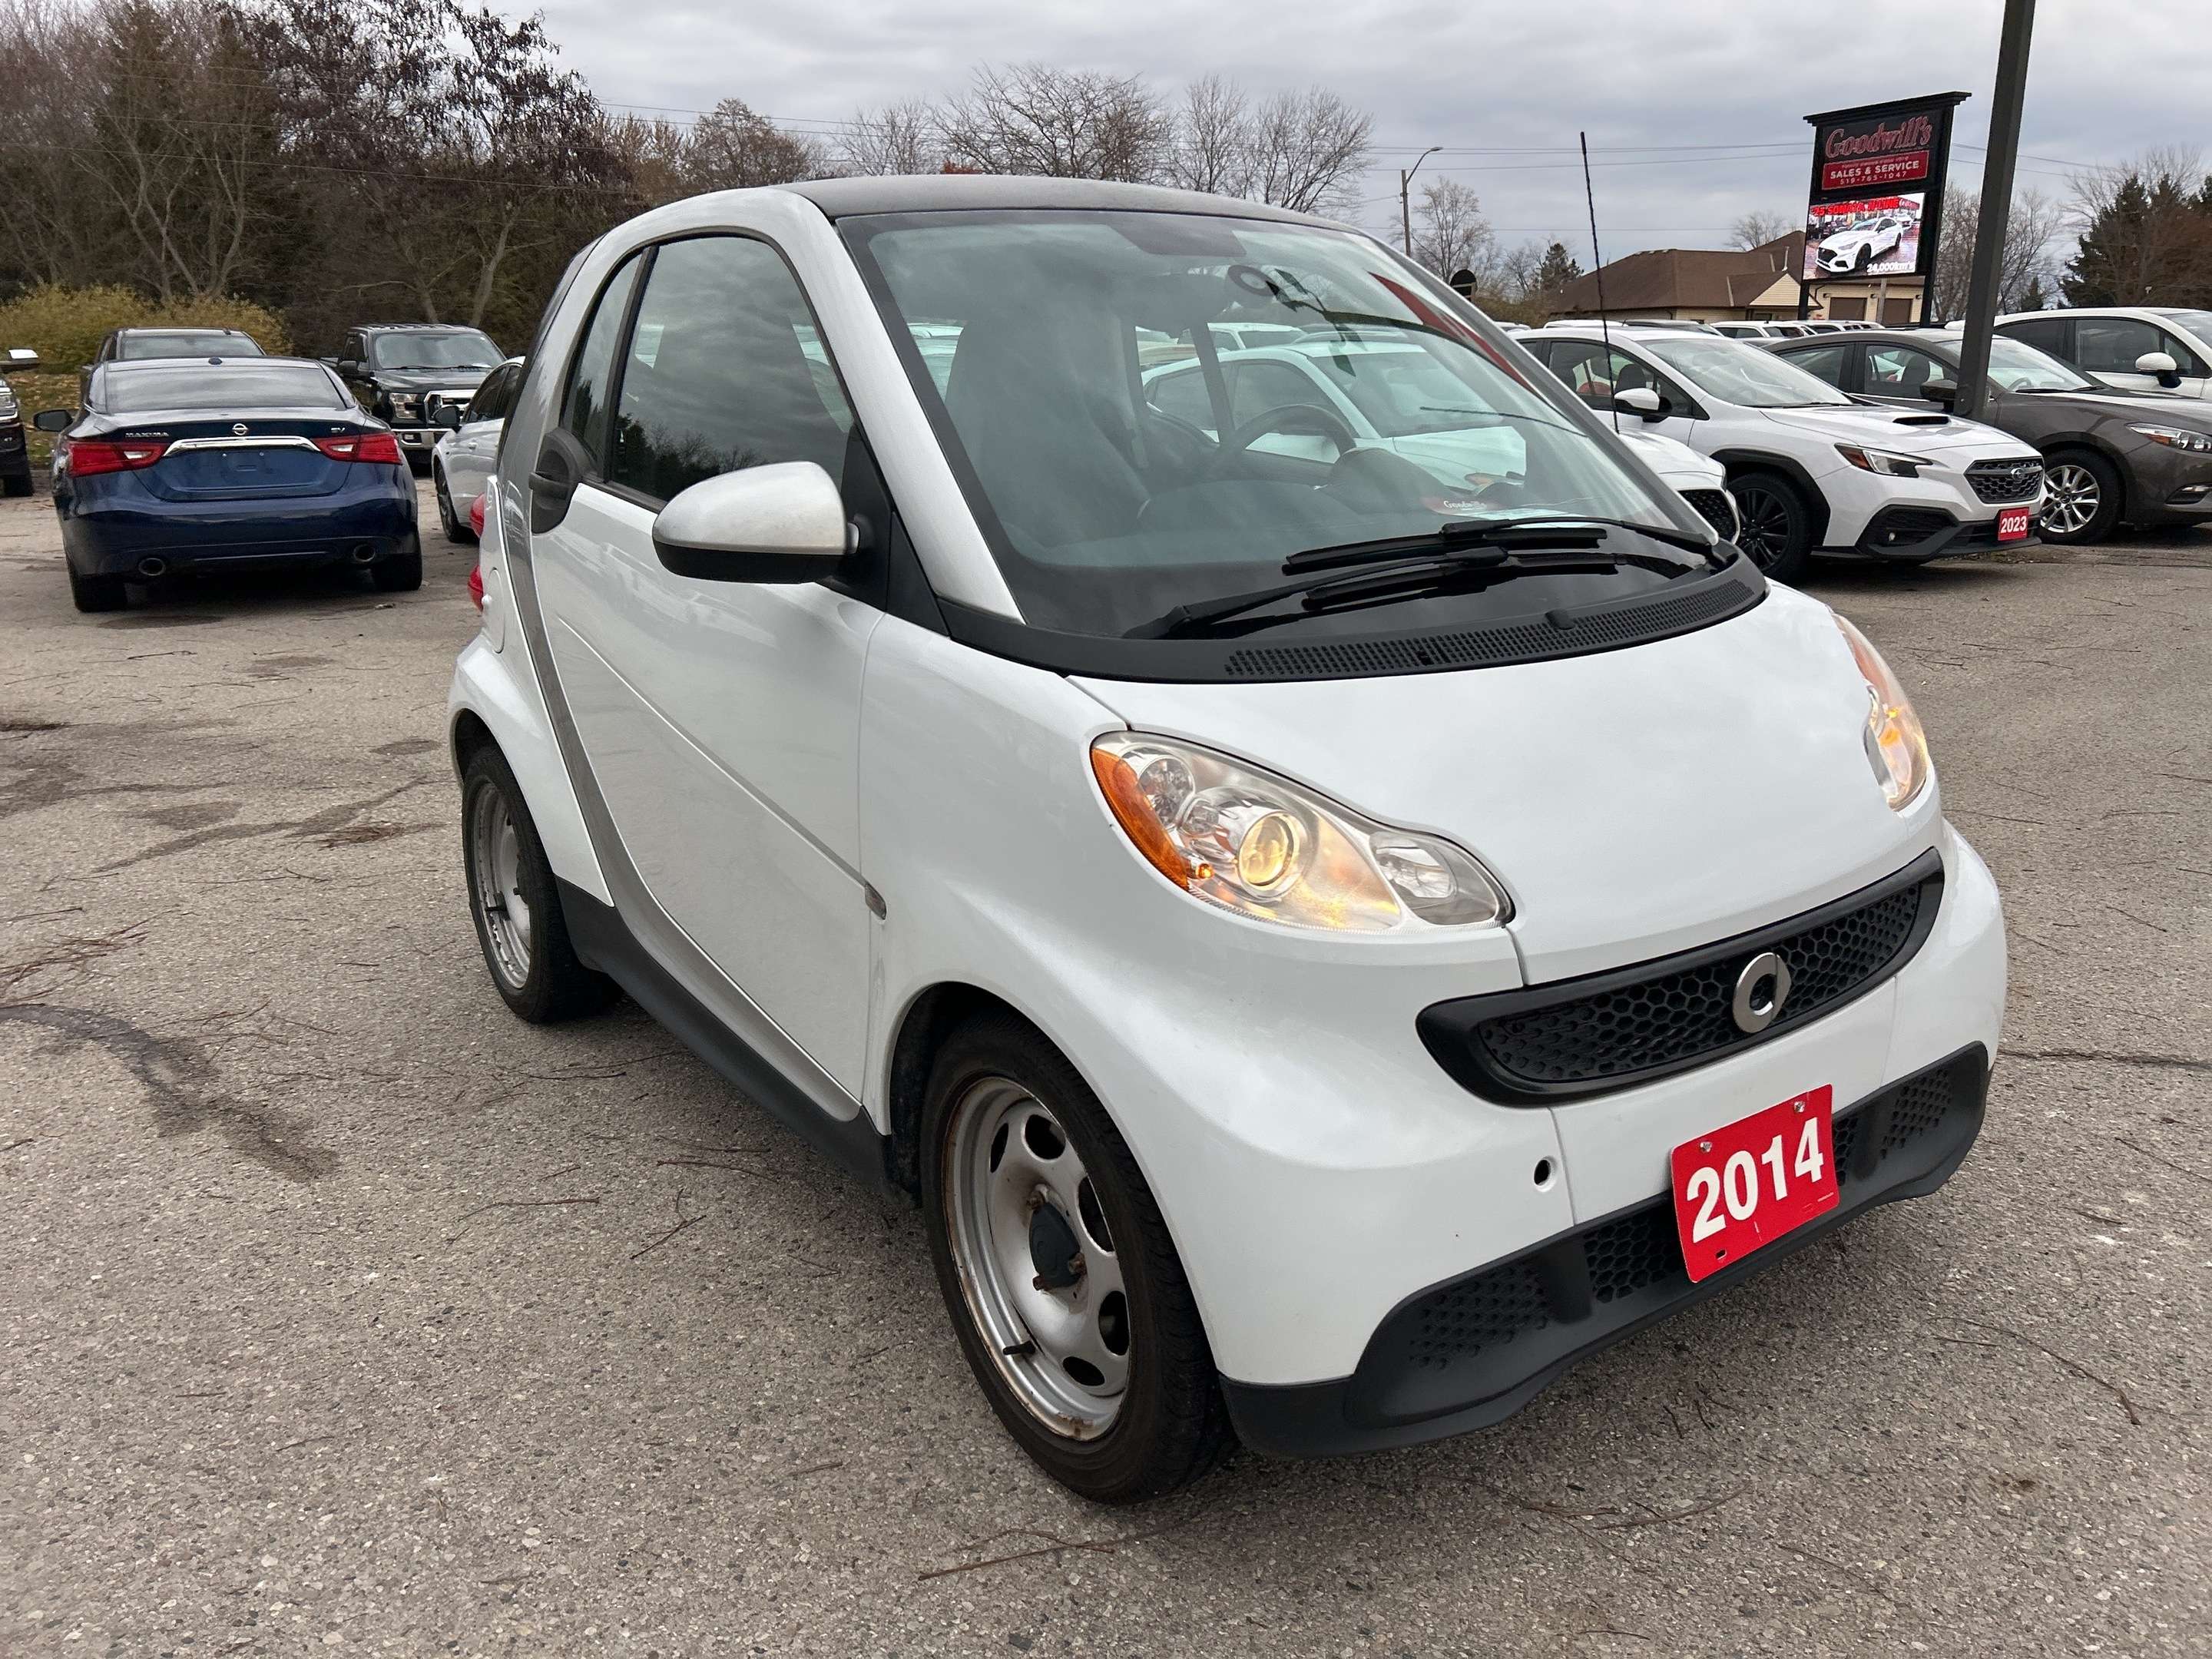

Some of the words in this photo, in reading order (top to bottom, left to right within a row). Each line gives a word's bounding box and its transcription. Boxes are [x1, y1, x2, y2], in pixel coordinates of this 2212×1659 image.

[1825, 116, 1932, 158] Goodwill's
[1830, 167, 1862, 179] SALES
[1865, 166, 1872, 174] &
[1875, 160, 1919, 174] SERVICE
[2000, 515, 2027, 534] 2023
[1687, 1117, 1824, 1243] 2014
